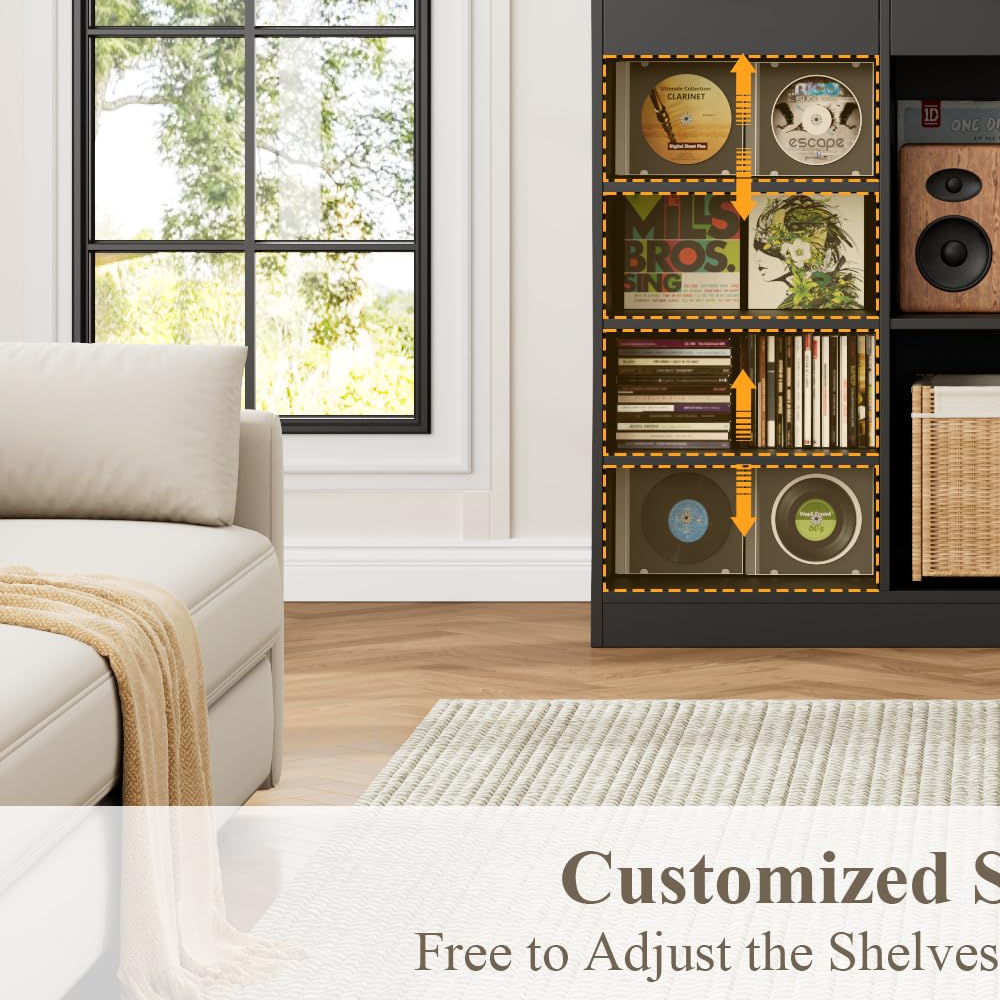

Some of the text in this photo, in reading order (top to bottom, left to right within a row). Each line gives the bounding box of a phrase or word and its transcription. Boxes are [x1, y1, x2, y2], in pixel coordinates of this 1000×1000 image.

[924, 107, 939, 122] 1D
[951, 119, 980, 133] ONE
[788, 137, 845, 151] escape
[624, 240, 736, 272] BROS.
[624, 273, 682, 292] SING
